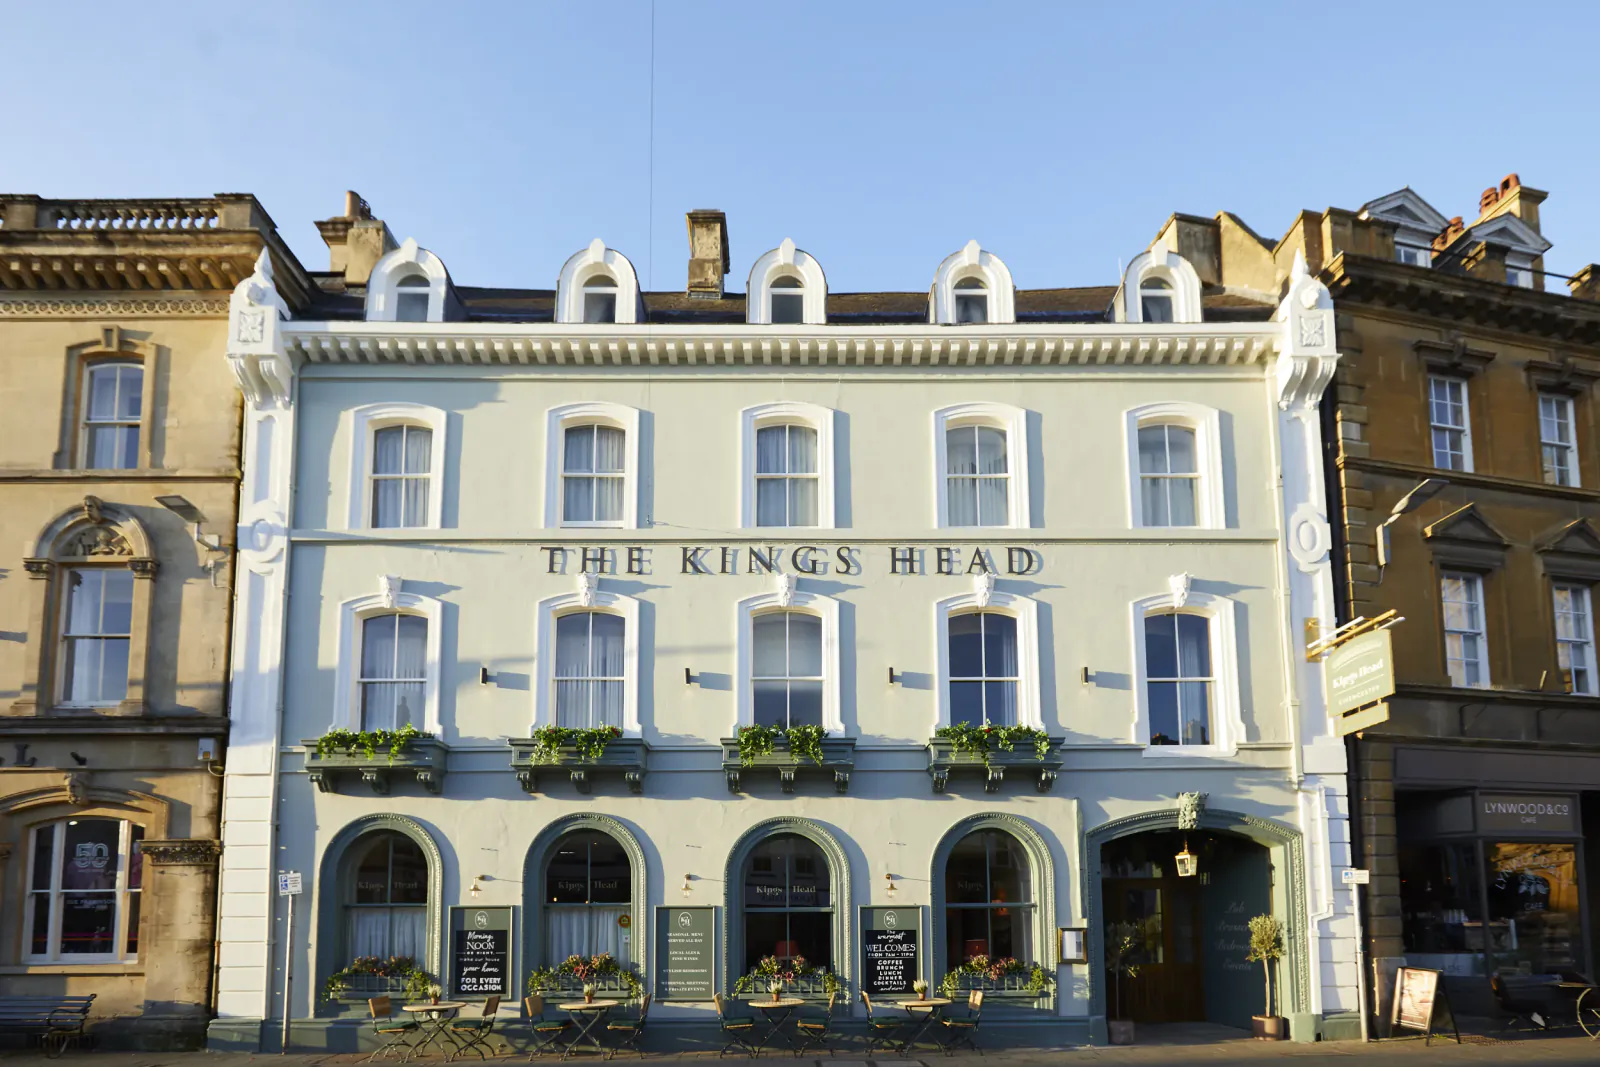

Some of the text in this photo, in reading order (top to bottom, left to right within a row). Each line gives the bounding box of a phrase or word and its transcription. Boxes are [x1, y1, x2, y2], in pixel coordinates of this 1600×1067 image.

[540, 546, 1034, 576] THE KINGS HEAD
[466, 941, 495, 950] NOON
[866, 943, 916, 952] WELCOMES
[462, 961, 499, 976] your home
